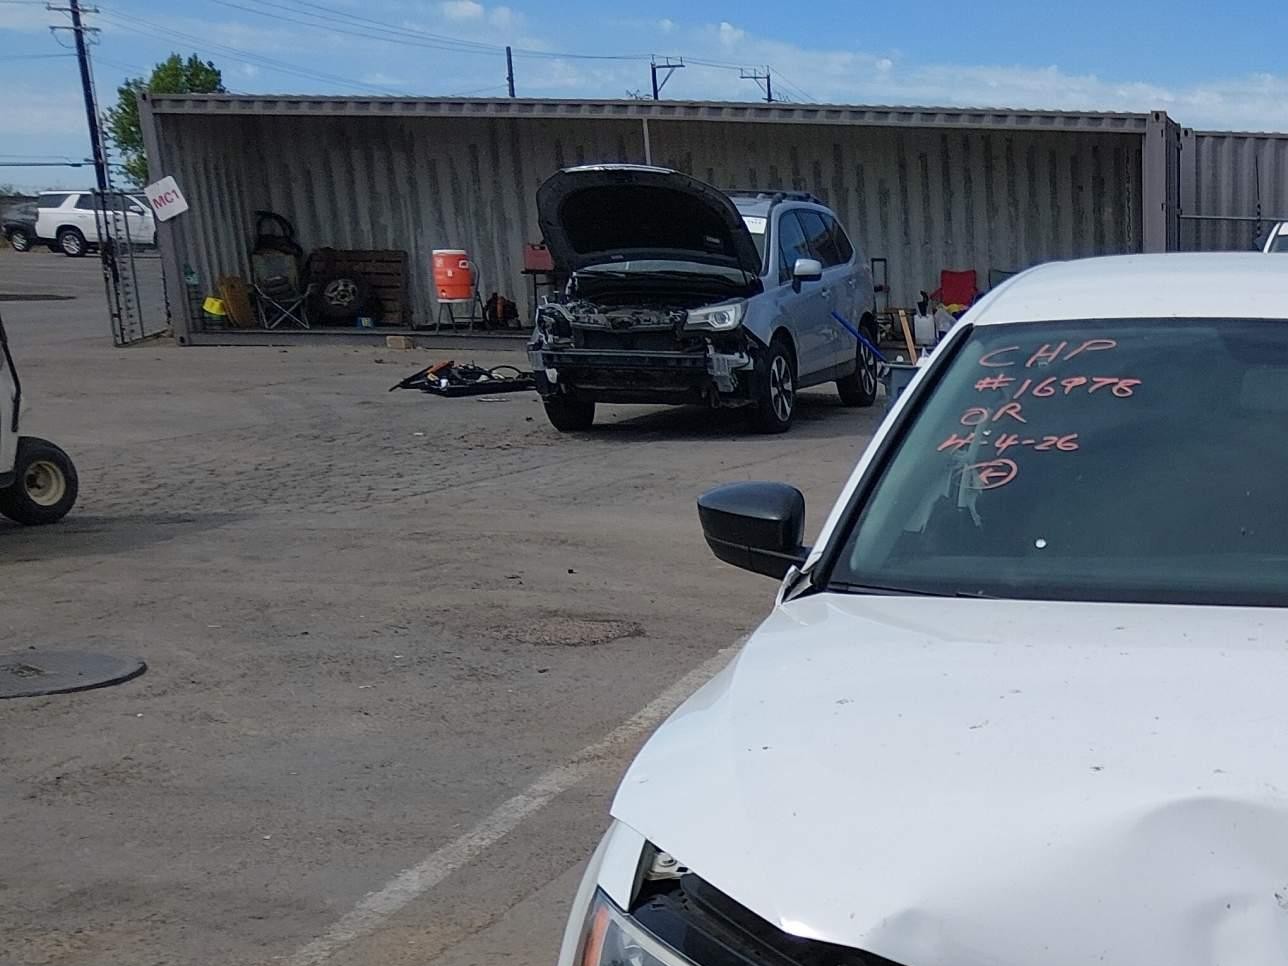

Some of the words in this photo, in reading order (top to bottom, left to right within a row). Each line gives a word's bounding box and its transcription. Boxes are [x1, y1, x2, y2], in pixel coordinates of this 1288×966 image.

[152, 189, 180, 209] MC1
[979, 340, 1117, 367] CHP
[960, 402, 1027, 425] OR
